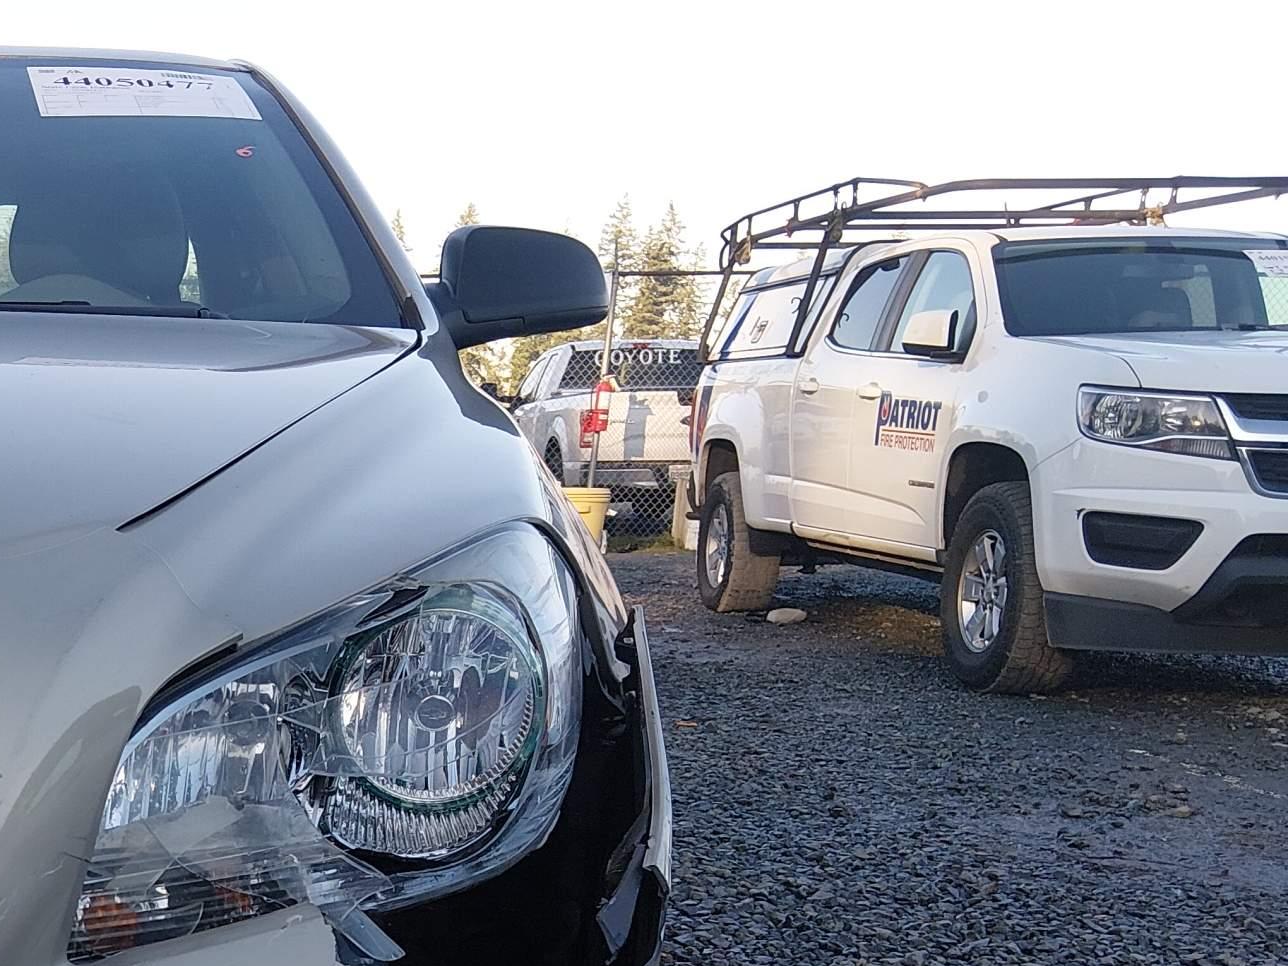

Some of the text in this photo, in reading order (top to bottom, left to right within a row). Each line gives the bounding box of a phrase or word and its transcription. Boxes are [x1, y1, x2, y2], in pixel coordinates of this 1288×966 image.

[53, 76, 213, 91] 44050477
[874, 390, 943, 446] PATRIOT
[880, 433, 936, 453] FIRE PROTECTION
